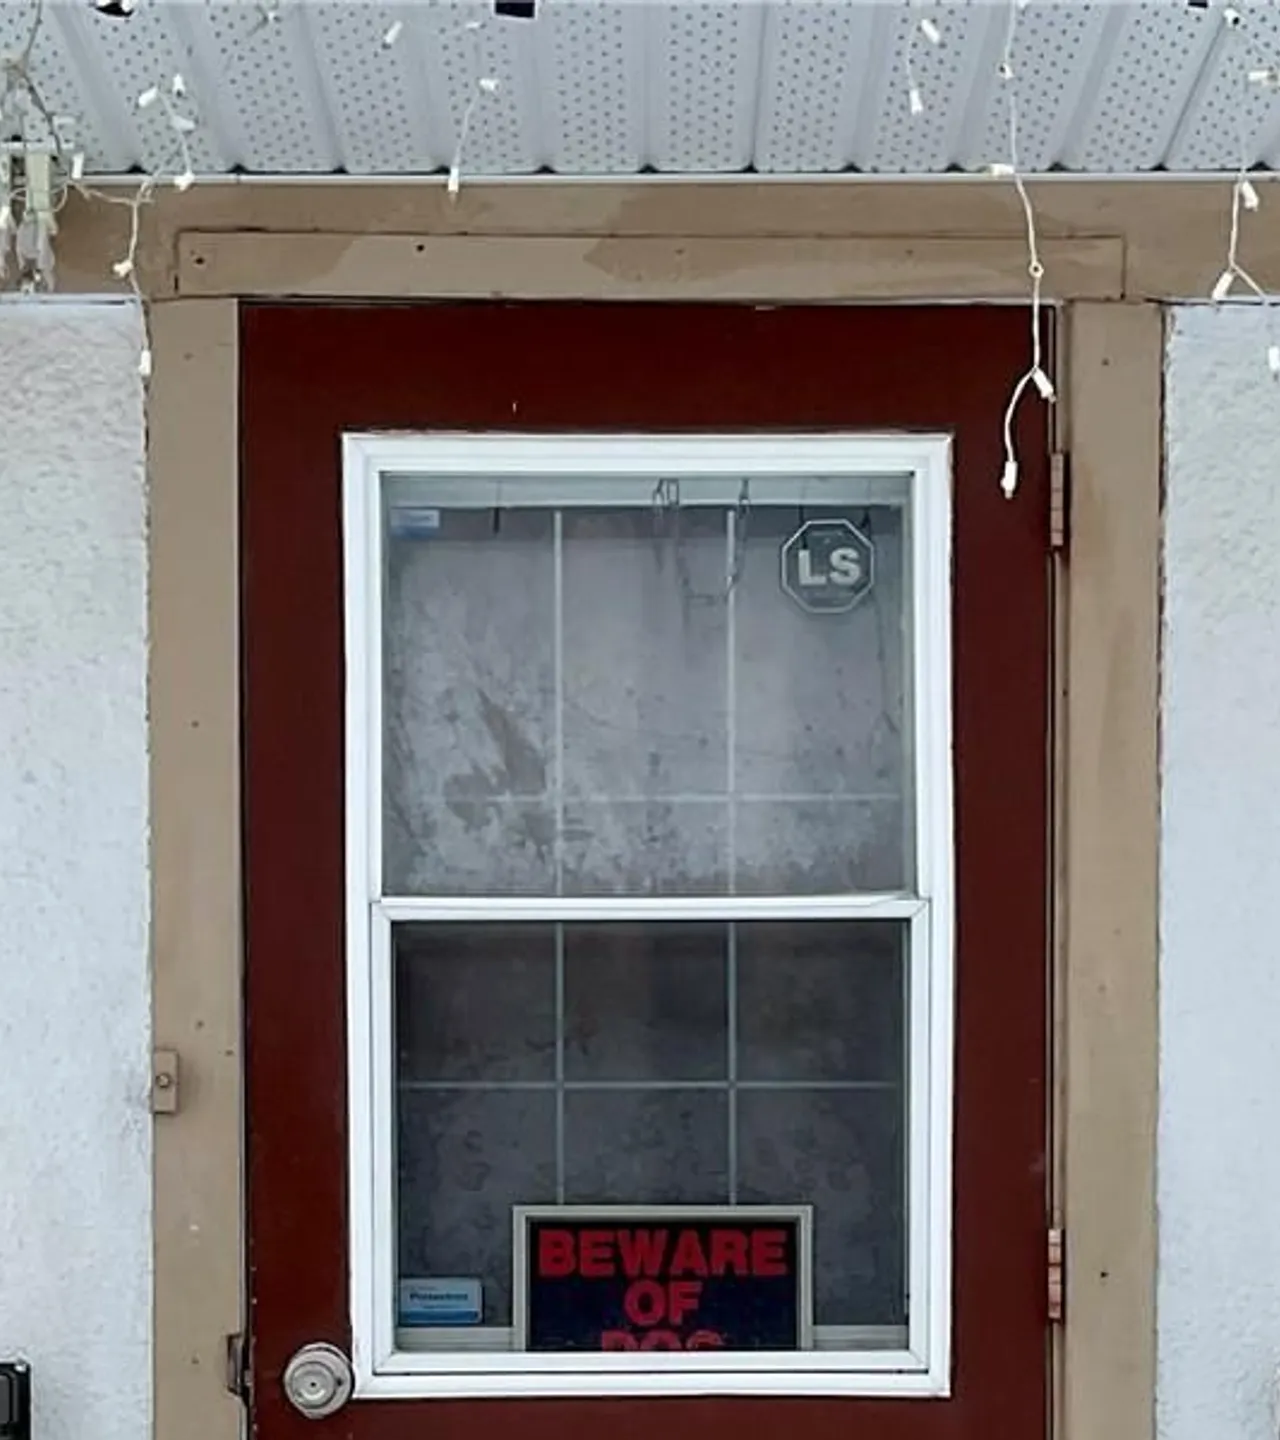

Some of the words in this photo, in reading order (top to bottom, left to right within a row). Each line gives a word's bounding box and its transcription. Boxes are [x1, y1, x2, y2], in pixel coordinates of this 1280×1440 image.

[798, 547, 861, 586] LS
[538, 1228, 788, 1277] BEWARE
[623, 1279, 703, 1326] OF
